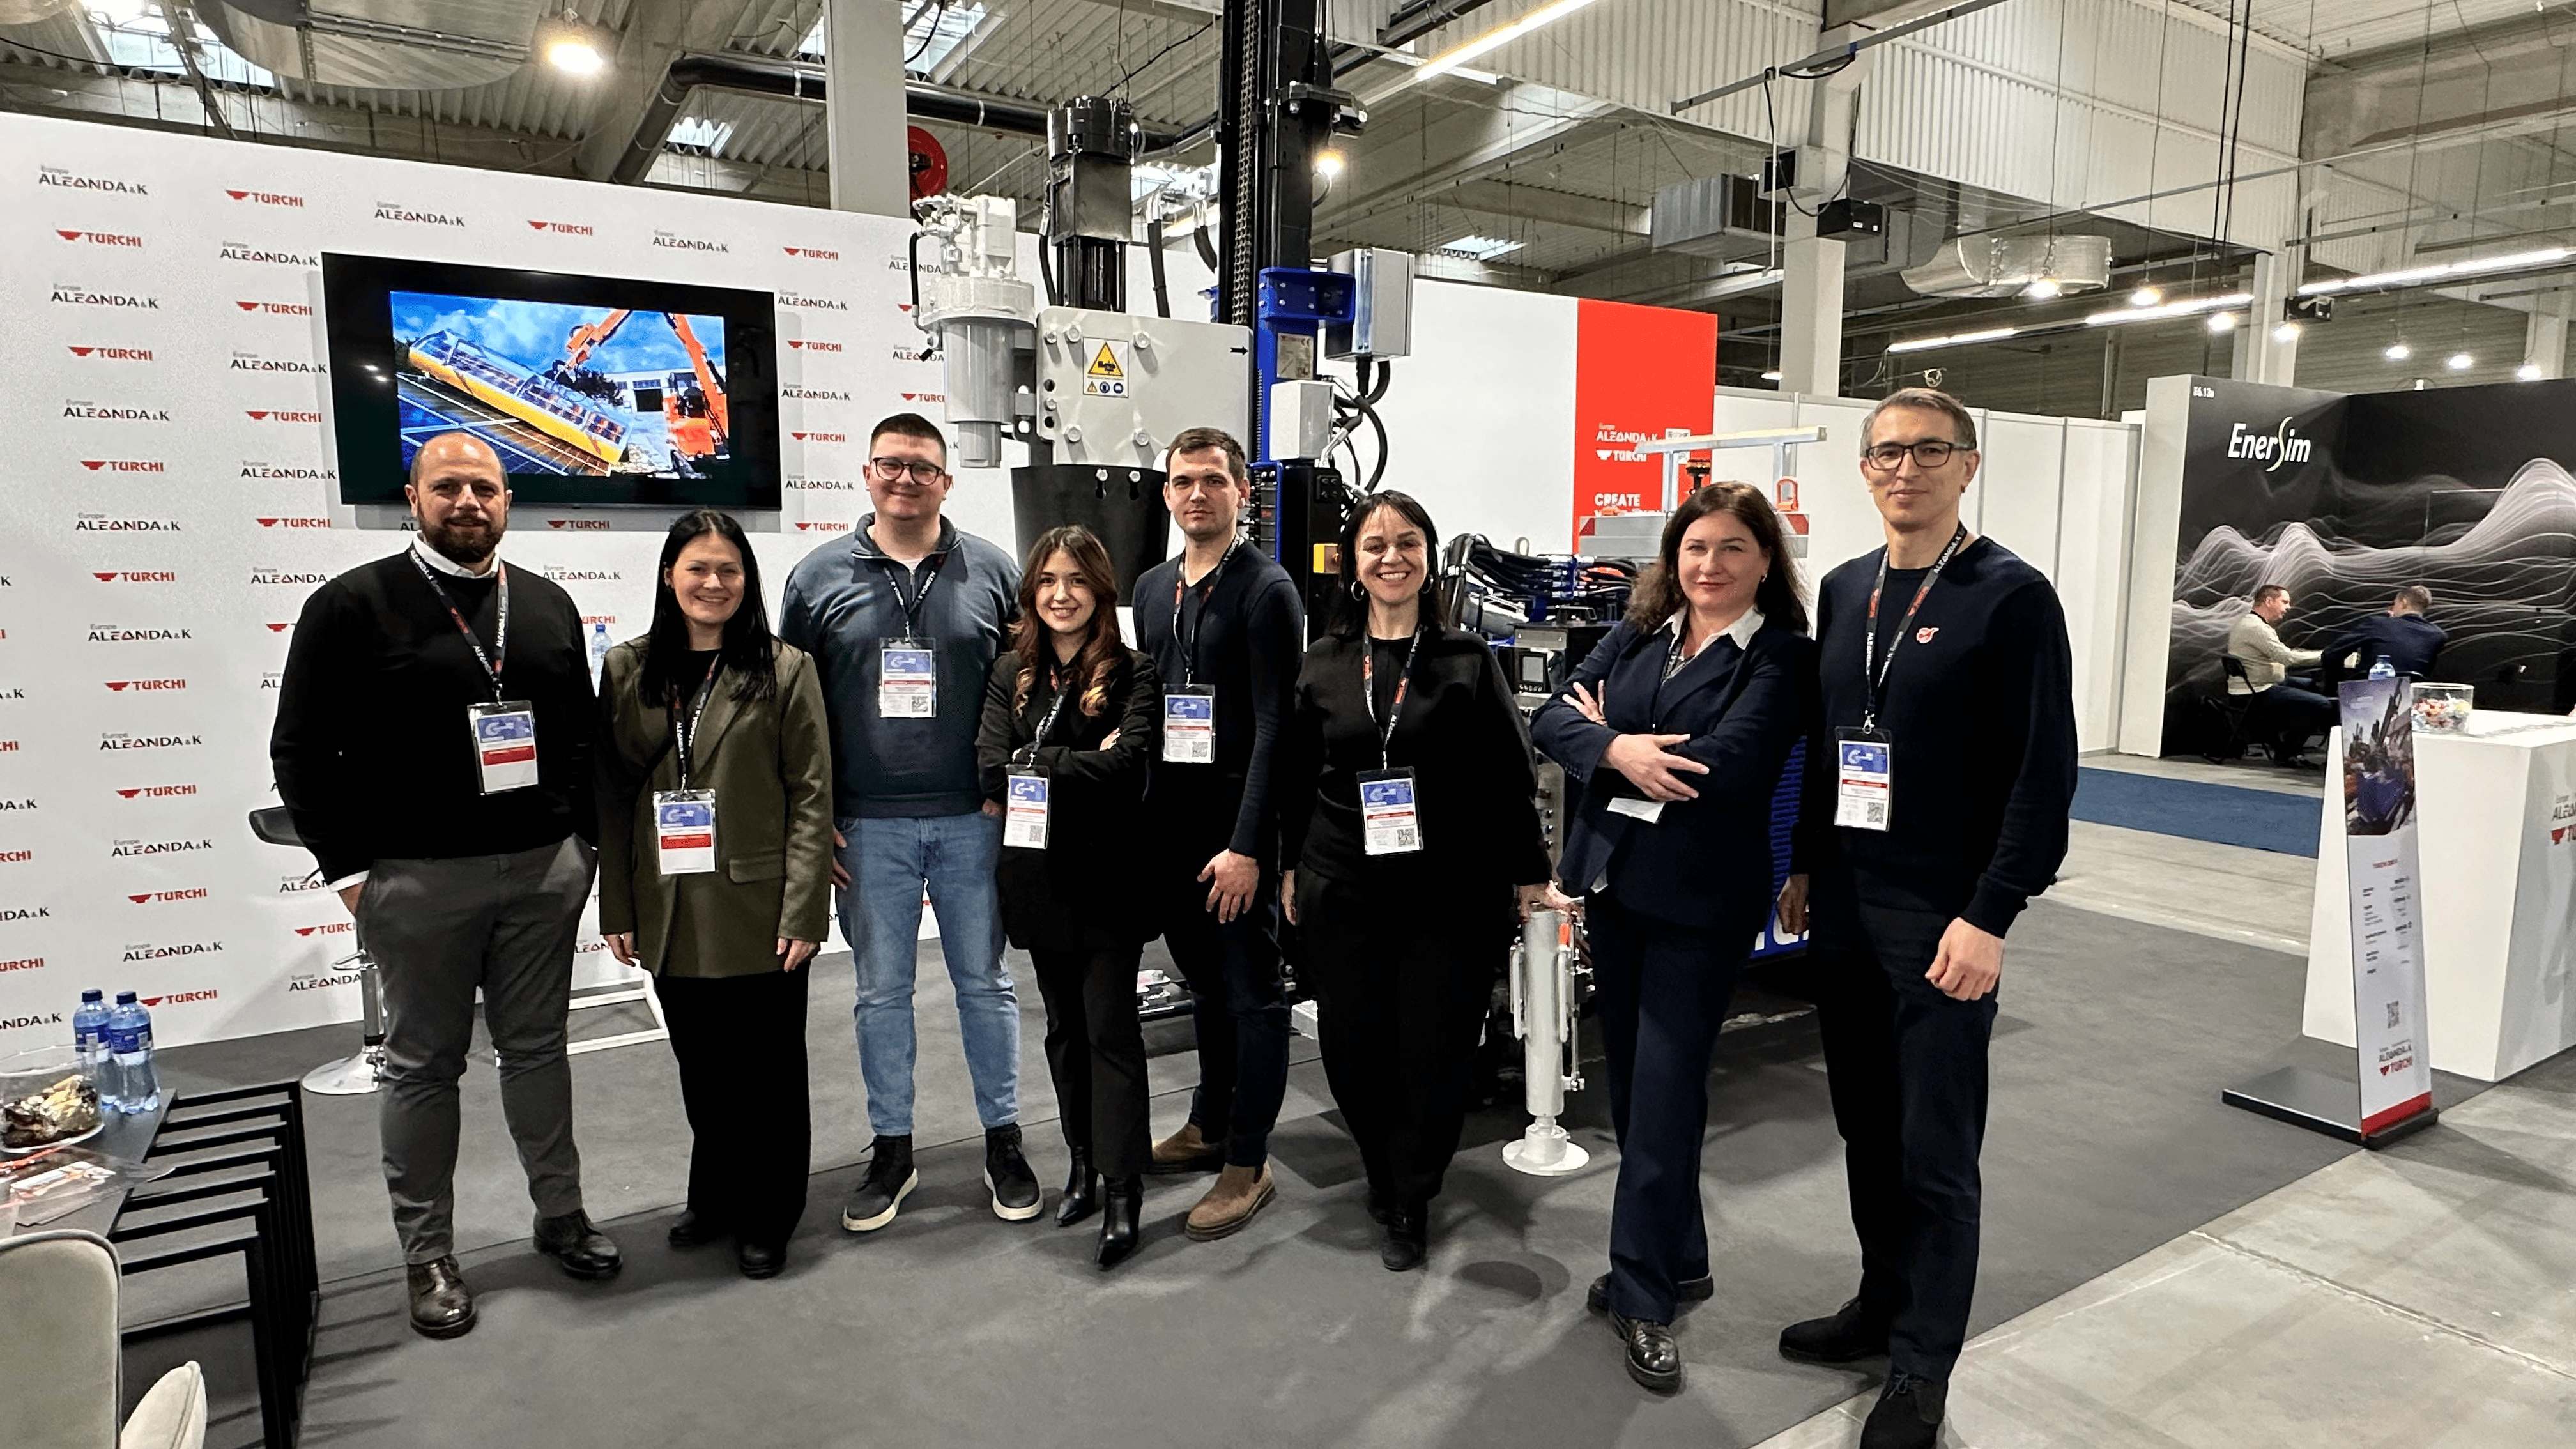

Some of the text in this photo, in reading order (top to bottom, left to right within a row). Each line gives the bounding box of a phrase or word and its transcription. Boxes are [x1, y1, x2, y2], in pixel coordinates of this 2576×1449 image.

[252, 193, 303, 206] TURCHI
[550, 223, 592, 236] TURCHI
[85, 233, 141, 247] TURCHI
[802, 249, 838, 260] TURCHI
[262, 303, 312, 316] TURCHI
[806, 342, 841, 351] TURCHI
[98, 348, 153, 360] TURCHI
[272, 412, 322, 422] TURCHI
[810, 433, 845, 441] TURCHI
[2227, 417, 2312, 472] EnerSim
[109, 461, 164, 471] TURCHI
[282, 518, 331, 528] TURCHI
[121, 572, 174, 581] TURCHI
[132, 679, 185, 691] TURCHI
[144, 785, 196, 797] TURCHI
[155, 889, 206, 901] TURCHI
[319, 923, 353, 934] TURC
[166, 990, 217, 1004] TURCHI
